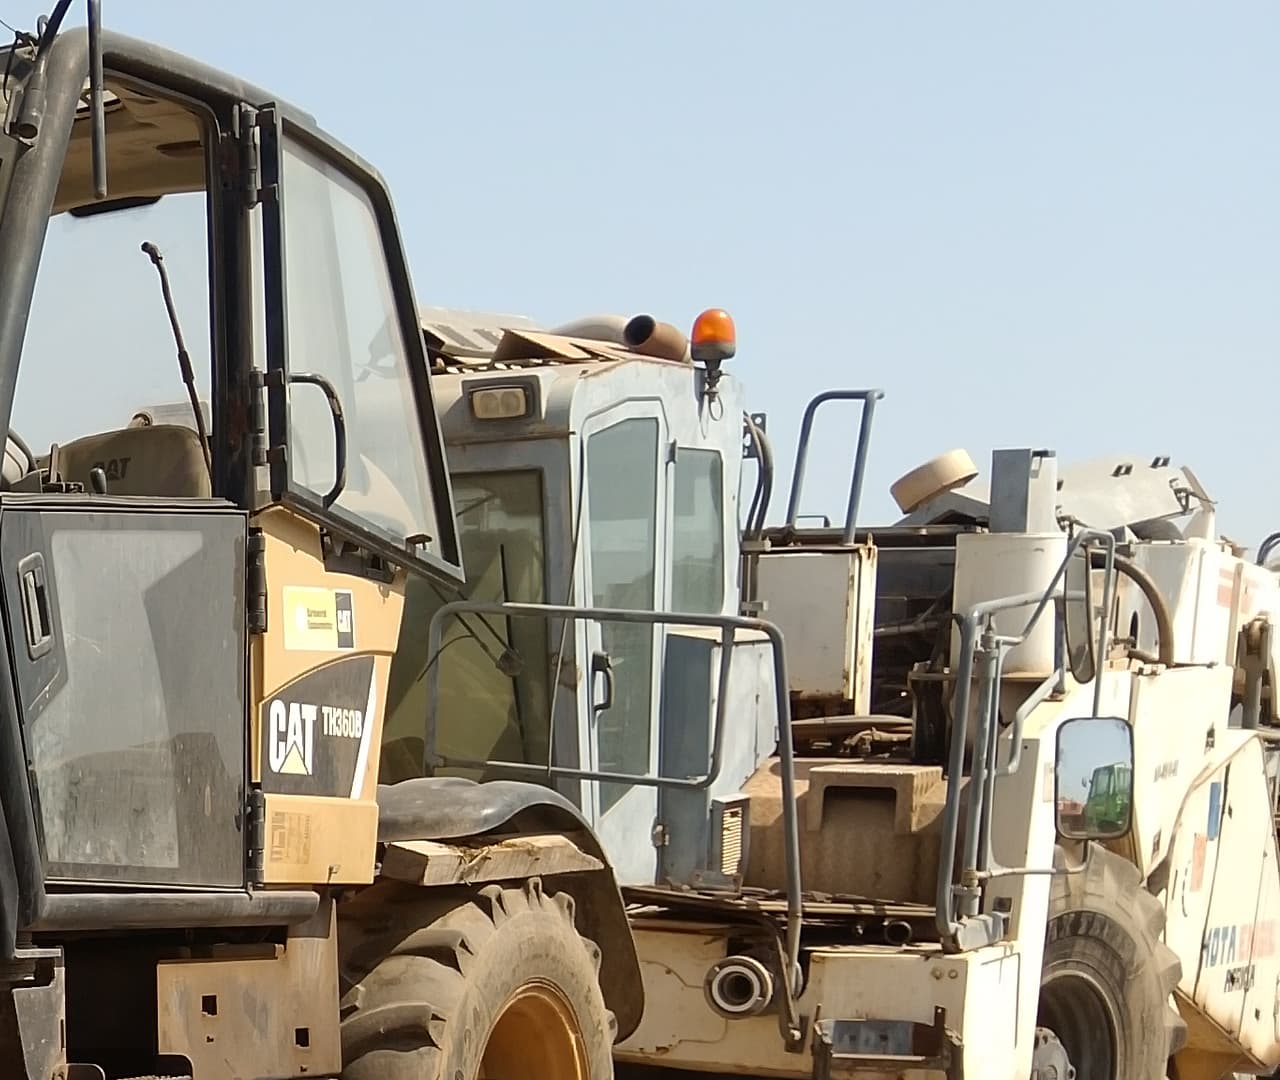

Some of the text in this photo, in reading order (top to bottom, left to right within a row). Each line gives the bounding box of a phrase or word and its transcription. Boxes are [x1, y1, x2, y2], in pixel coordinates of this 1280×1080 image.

[95, 456, 131, 480] AT
[269, 699, 362, 776] CAT TH360B
